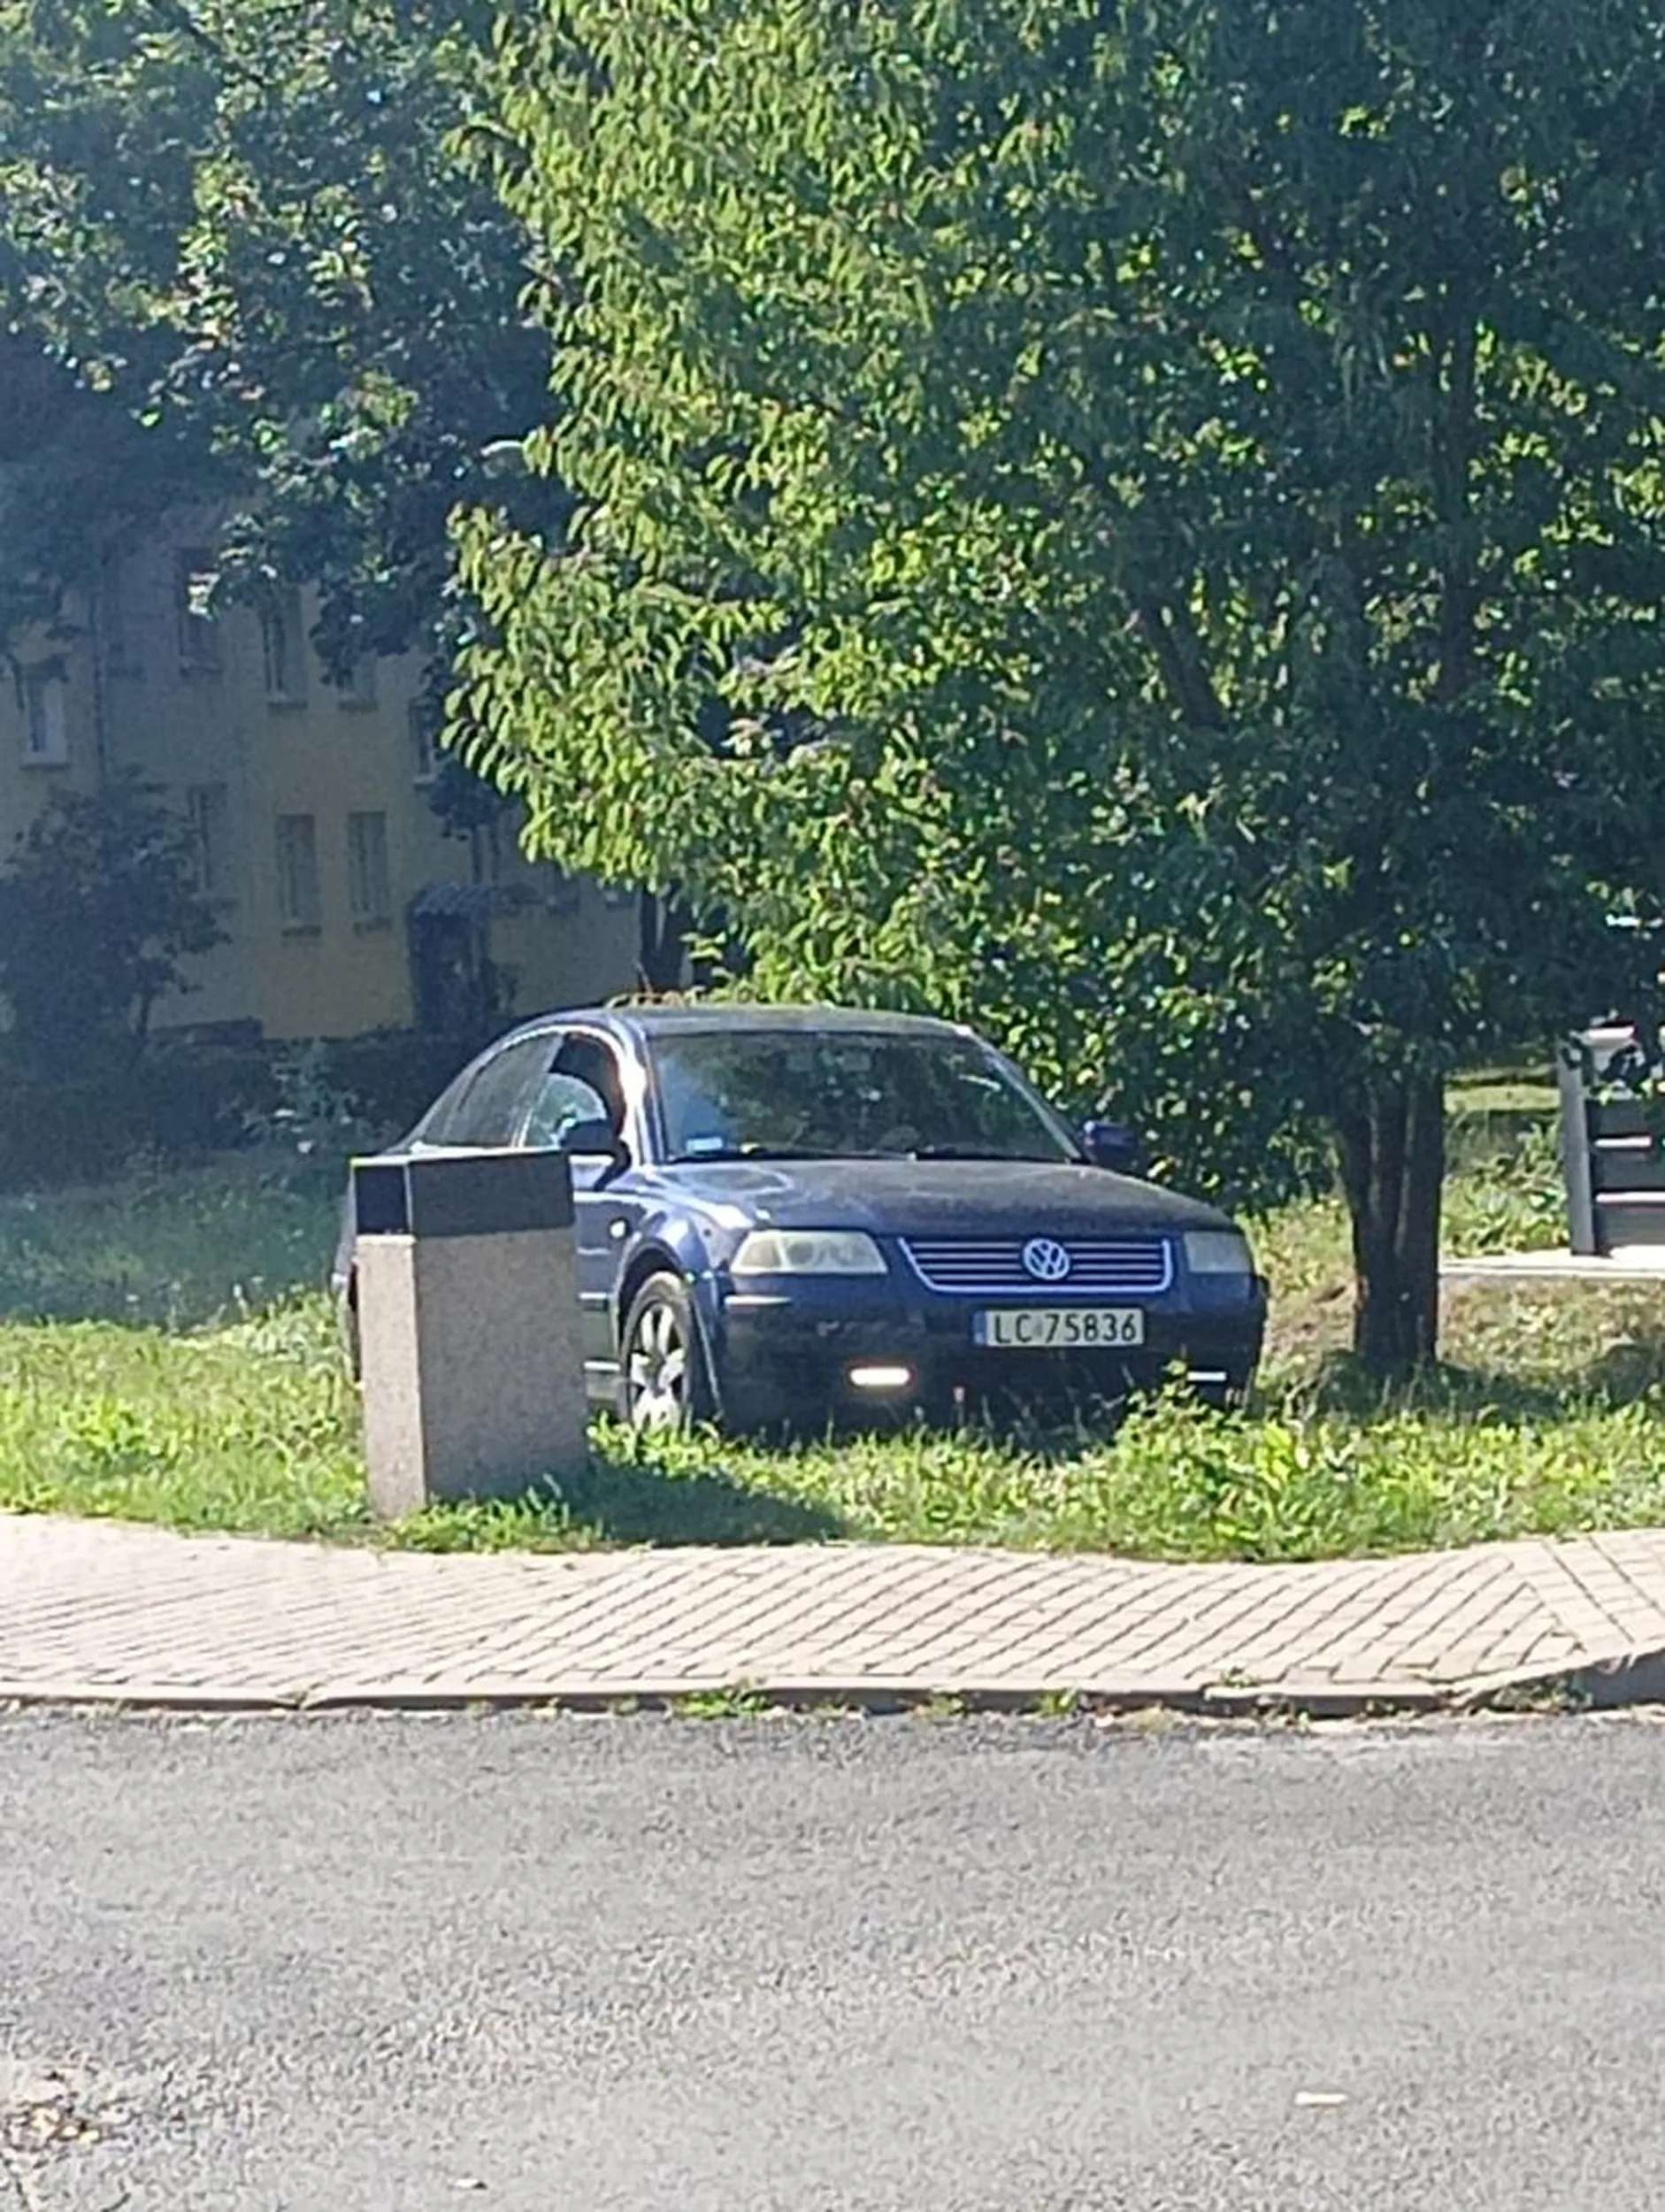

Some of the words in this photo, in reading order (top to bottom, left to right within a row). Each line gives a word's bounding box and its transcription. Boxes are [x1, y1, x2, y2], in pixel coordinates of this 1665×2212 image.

[1024, 1239, 1070, 1279] VW
[994, 1314, 1032, 1343] LC
[1045, 1313, 1137, 1343] 75836
